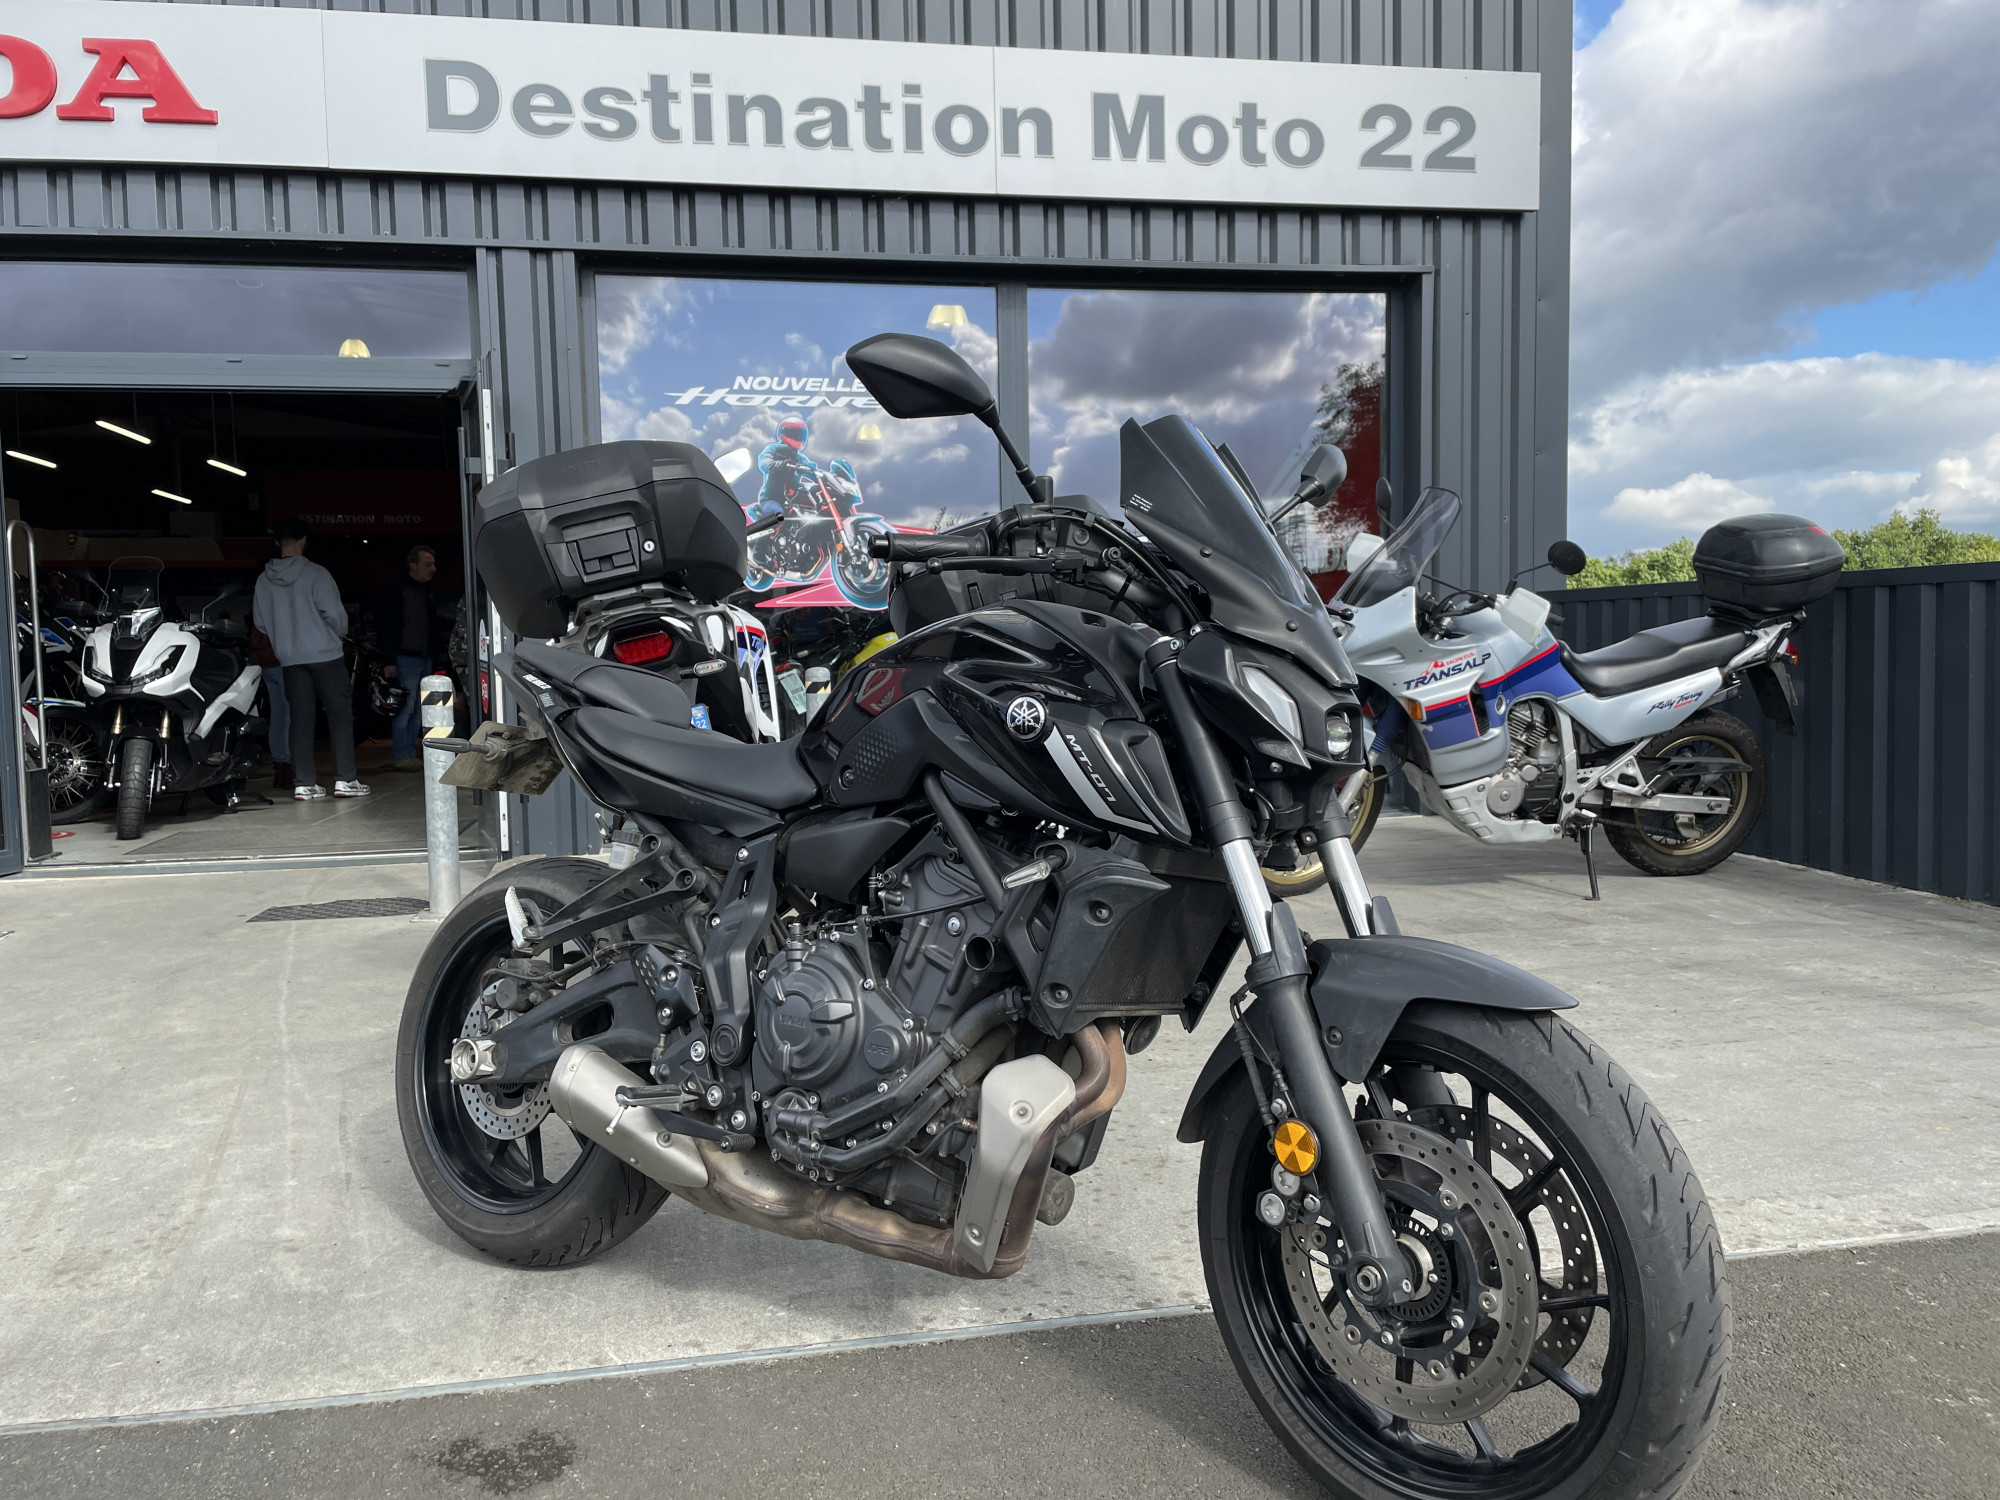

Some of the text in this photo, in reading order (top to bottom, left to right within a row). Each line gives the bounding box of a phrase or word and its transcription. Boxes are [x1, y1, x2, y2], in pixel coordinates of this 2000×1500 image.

[422, 56, 1478, 174] Destination Moto 22
[732, 375, 867, 393] NOUVELLE
[663, 385, 884, 409] HORNE
[383, 514, 422, 524] MOTO
[1446, 651, 1476, 666] HONDA
[1403, 652, 1492, 691] TRANSALP
[695, 718, 708, 729] 22
[1065, 734, 1117, 802] MT-07
